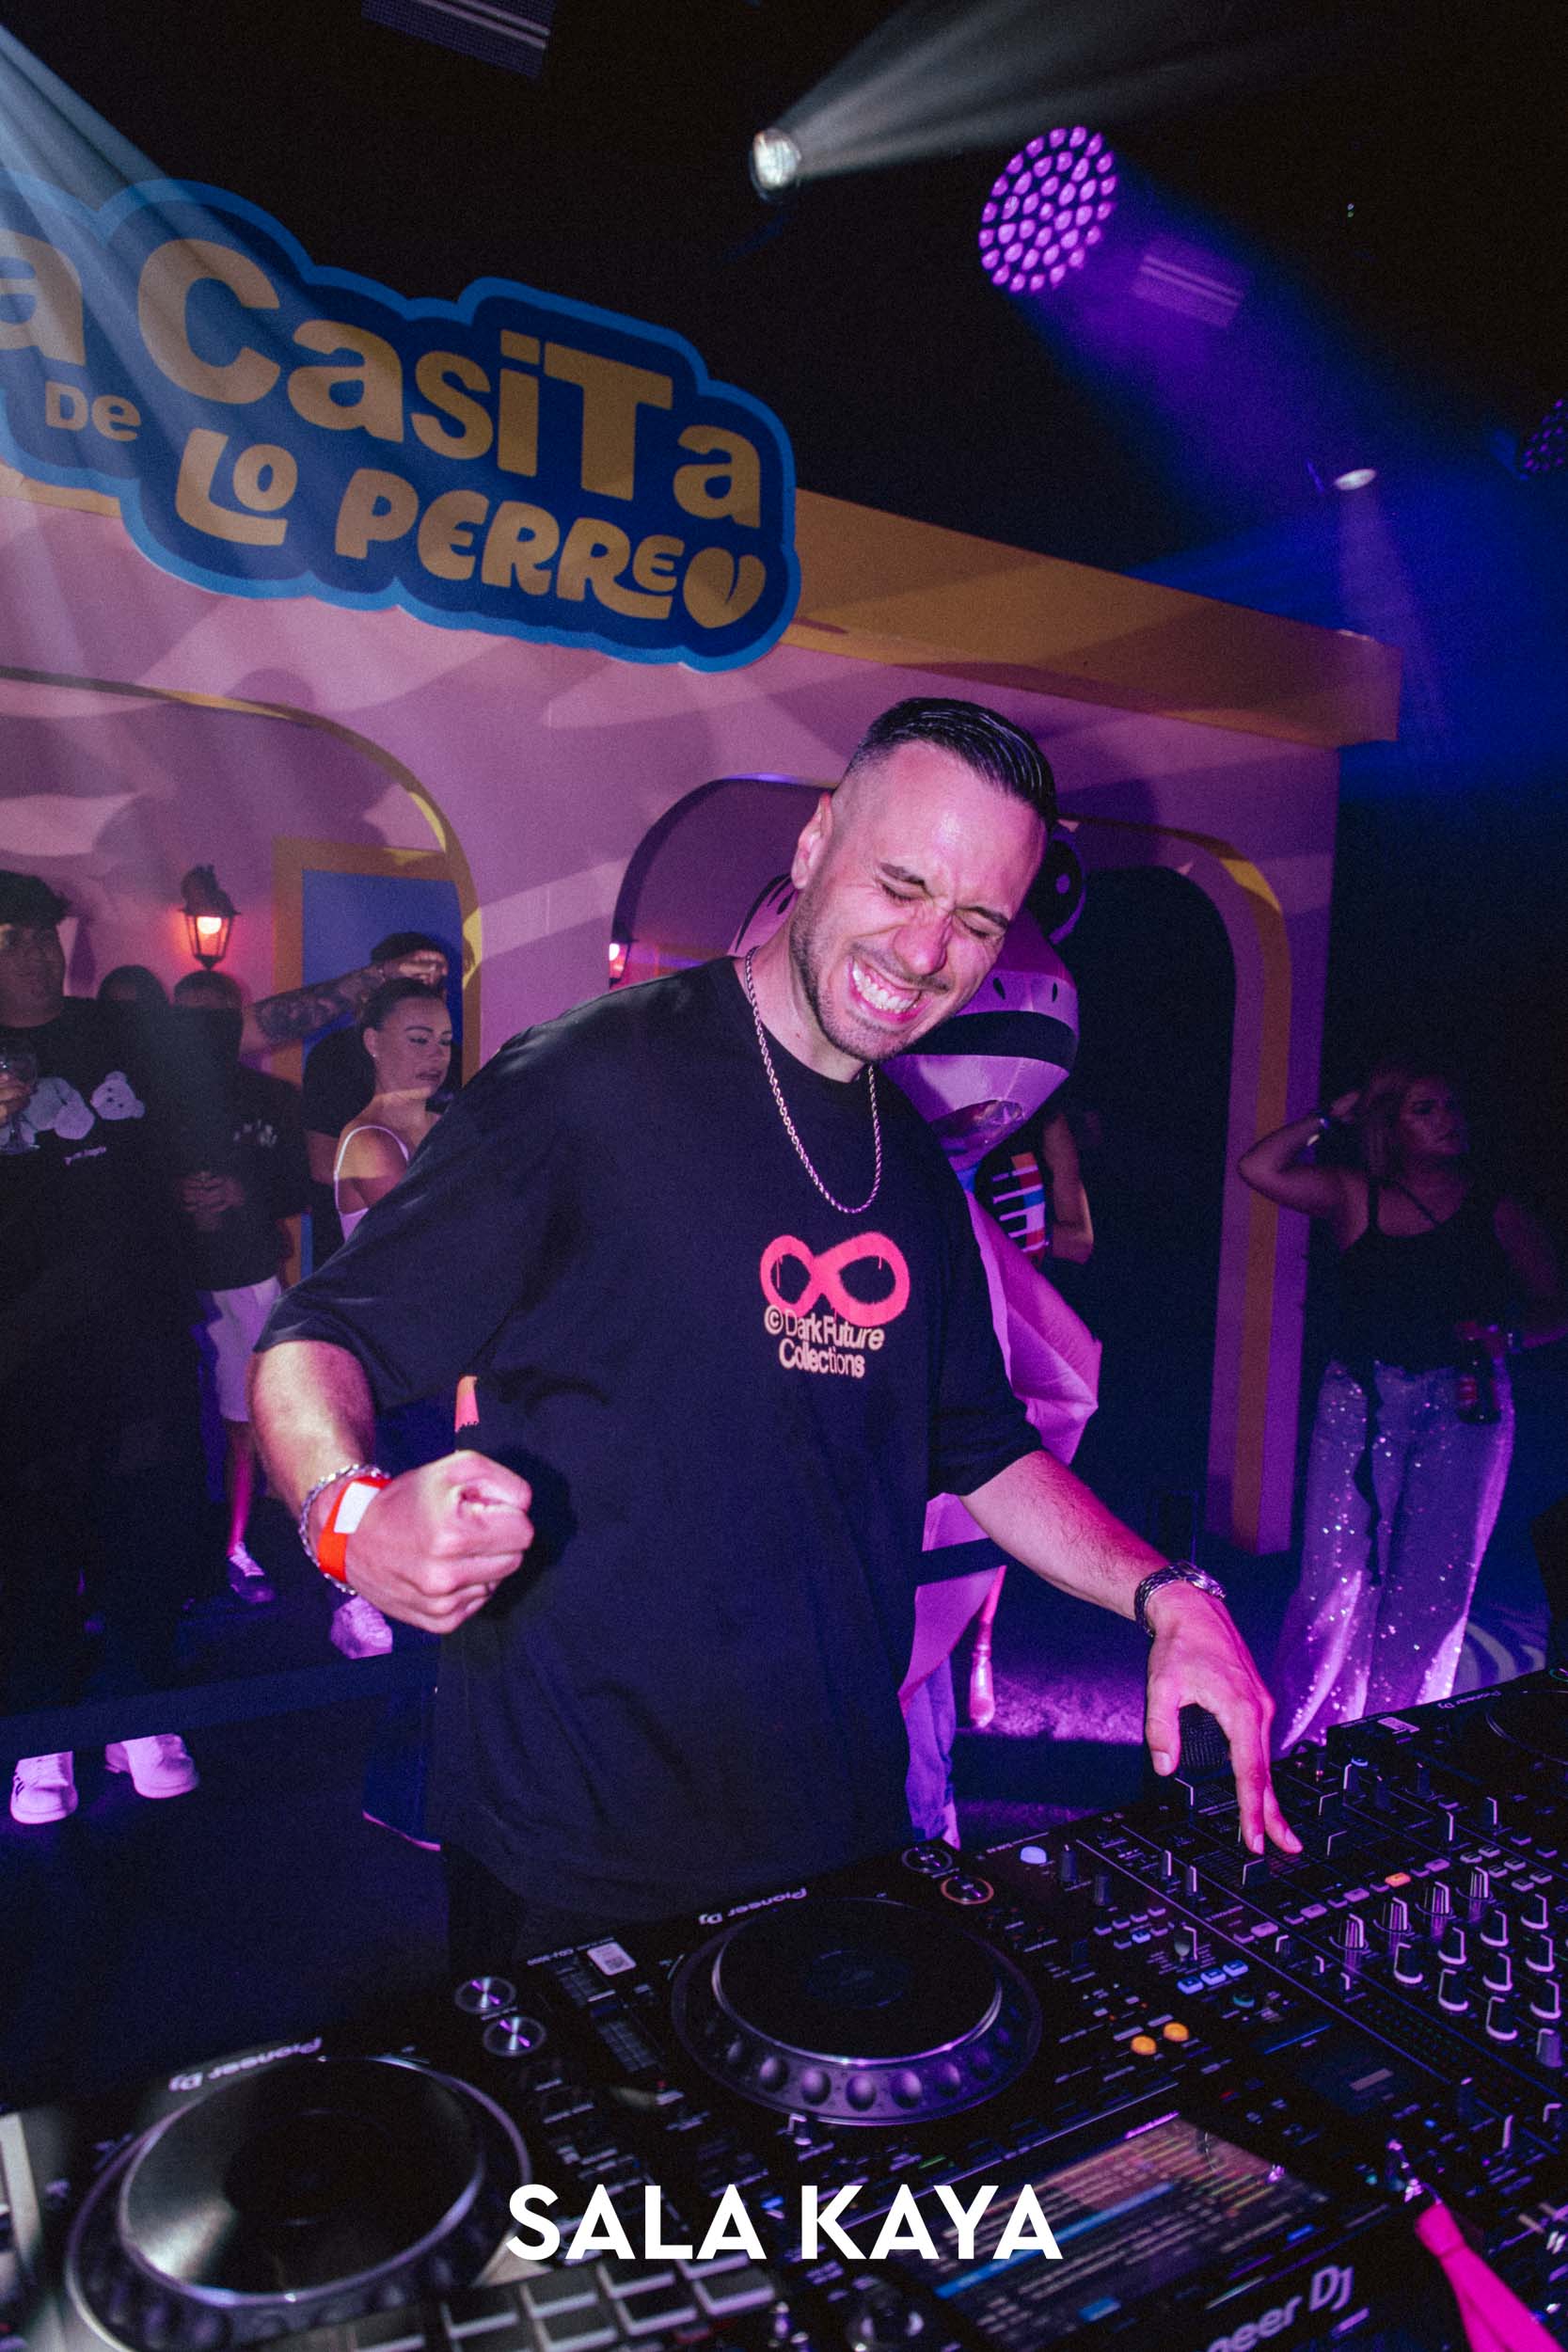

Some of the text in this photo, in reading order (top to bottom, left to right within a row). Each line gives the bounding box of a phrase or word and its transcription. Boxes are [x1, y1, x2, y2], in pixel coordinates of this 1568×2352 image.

[0, 229, 87, 367] a
[779, 1338, 865, 1378] Collections
[1309, 2265, 1354, 2312] DJ
